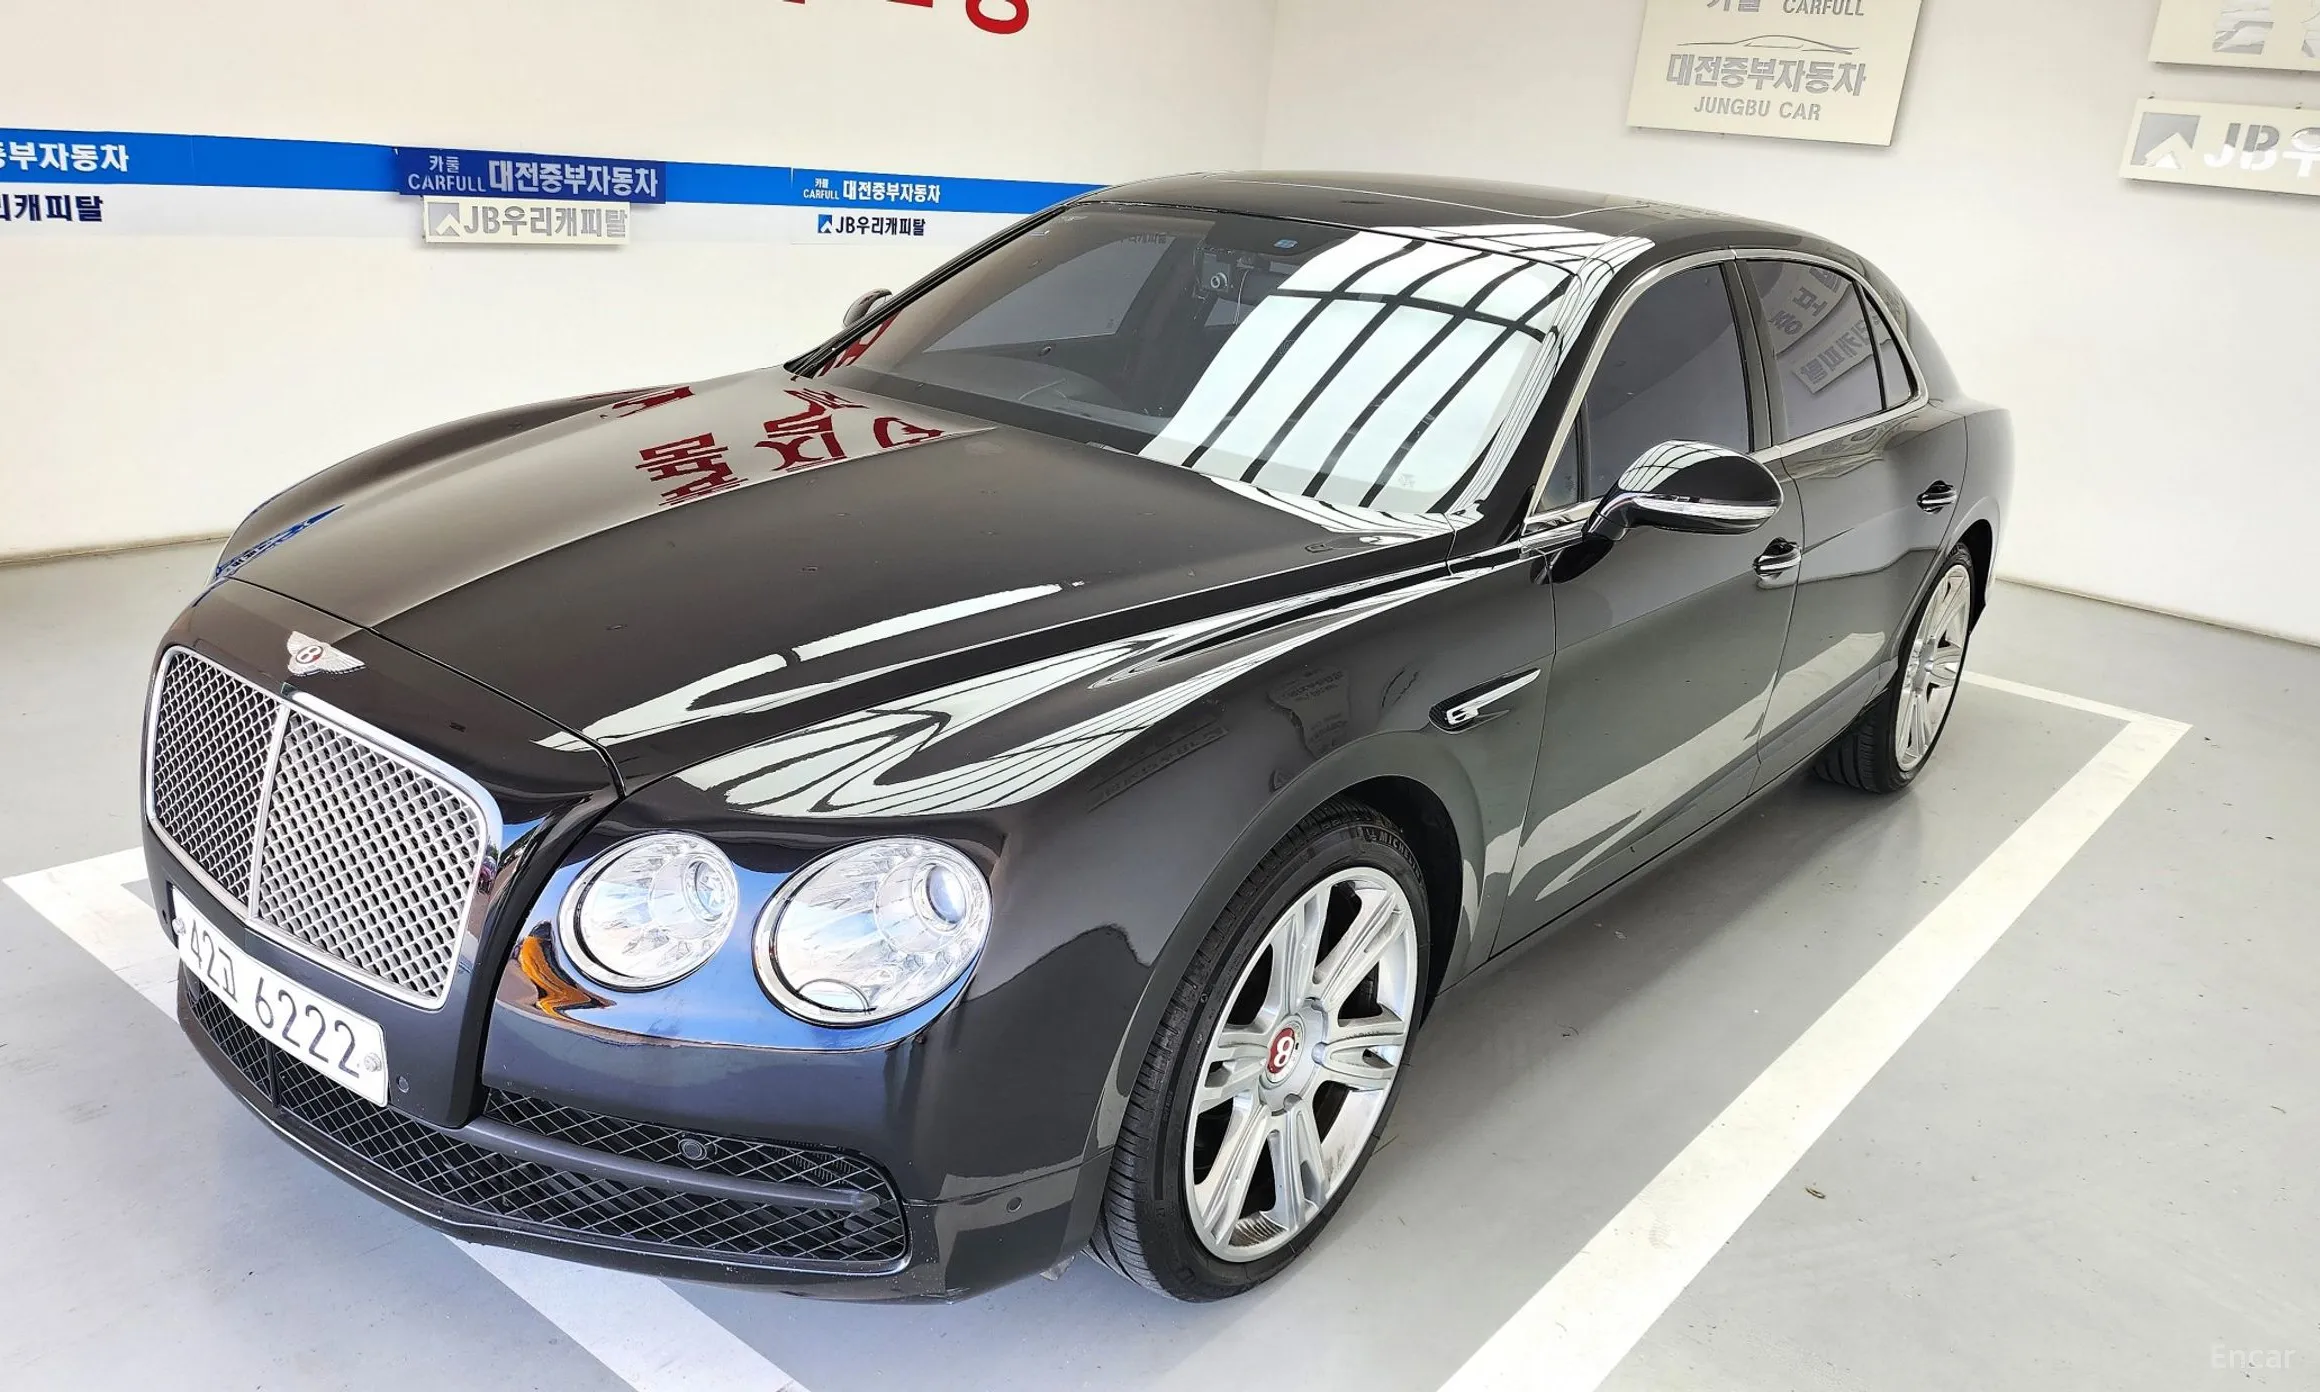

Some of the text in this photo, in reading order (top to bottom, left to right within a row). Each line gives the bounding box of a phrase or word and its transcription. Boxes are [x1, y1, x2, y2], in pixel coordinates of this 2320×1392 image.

[1783, 0, 1864, 16] CARFULL
[1666, 53, 1866, 96] 대전중부자동차
[1694, 96, 1822, 121] JUNGBU CAR
[0, 141, 129, 172] 부자동차
[408, 173, 487, 192] CARFULL
[488, 159, 658, 198] 대전중부자동차
[803, 189, 839, 200] CARFULL
[842, 180, 940, 203] 대전중부자동차
[463, 205, 628, 238] JB우리캐피탈
[835, 215, 926, 236] JB우리캐피탈
[190, 919, 360, 1079] 42고 6222
